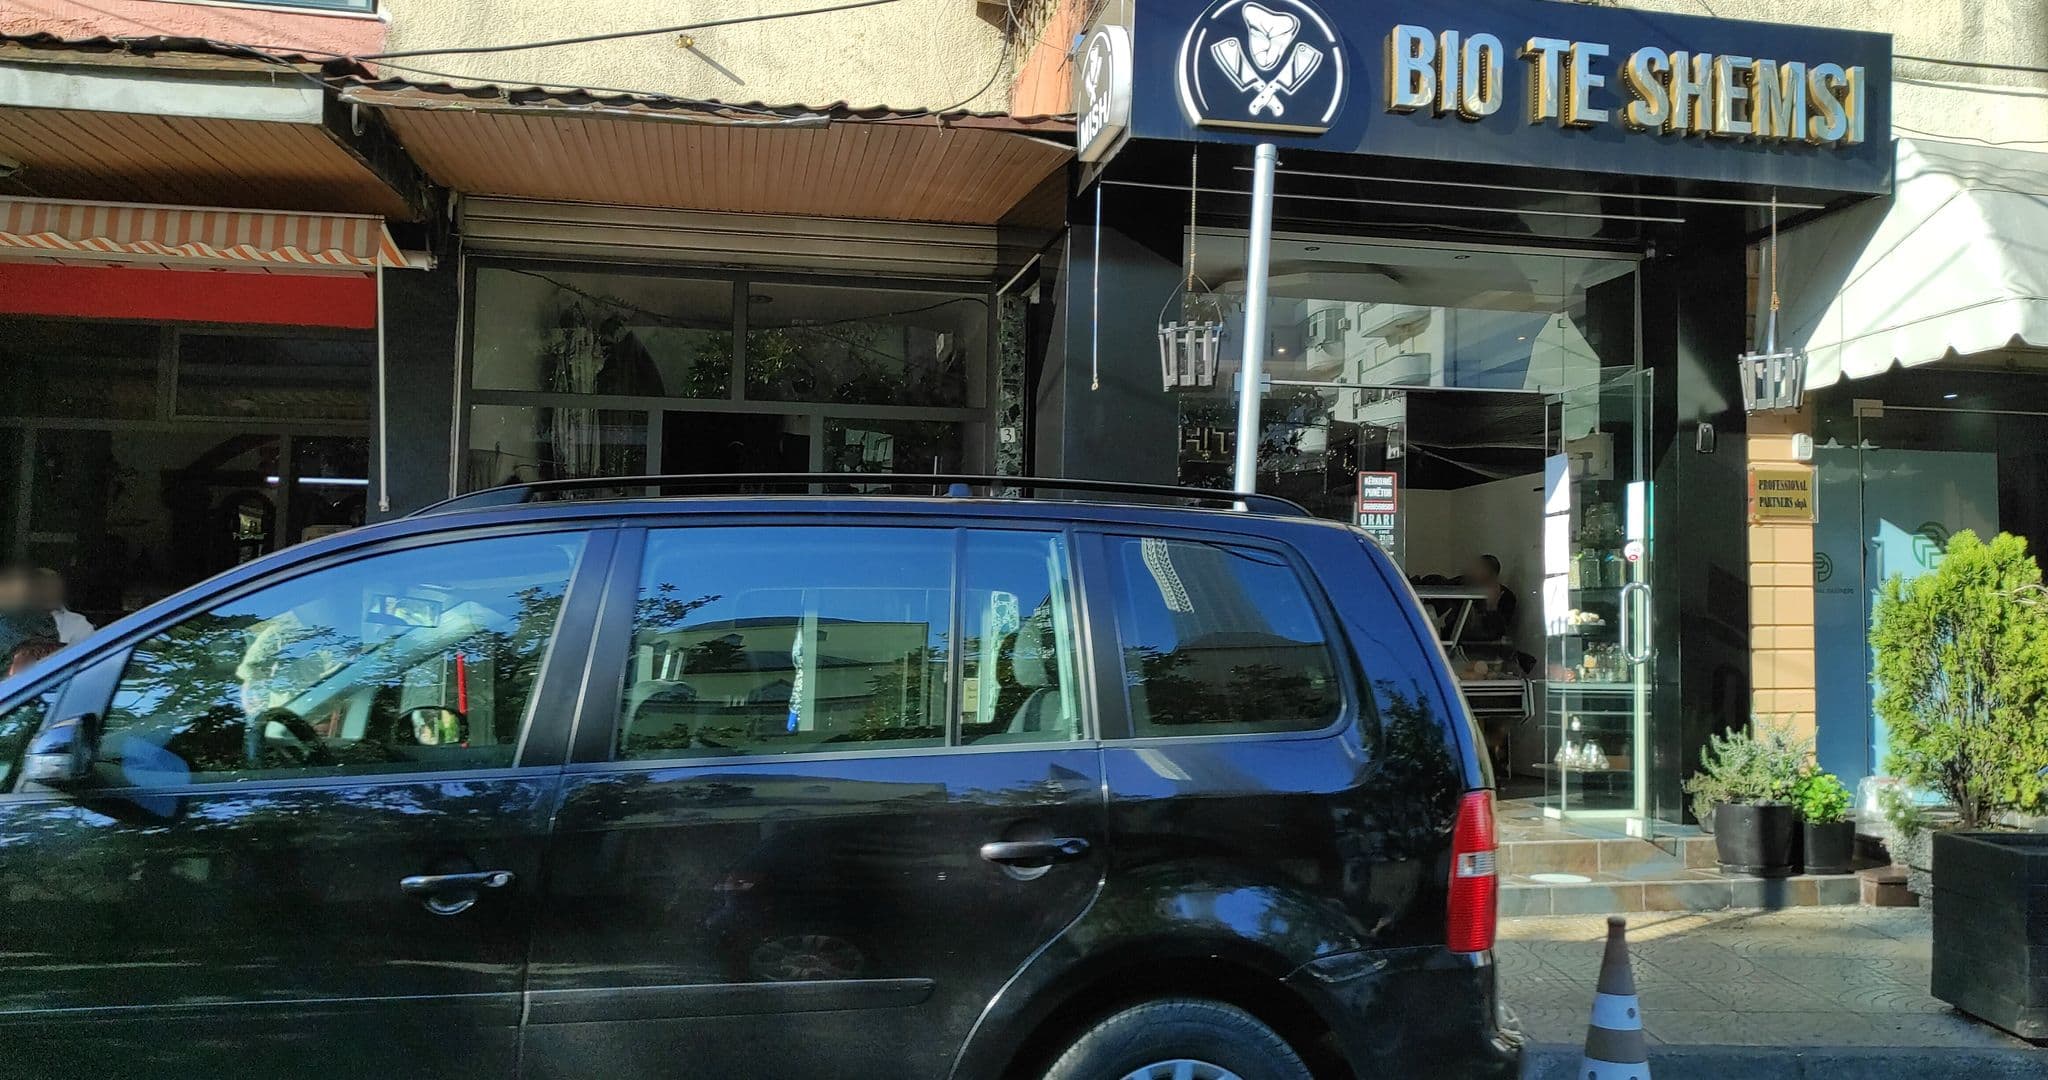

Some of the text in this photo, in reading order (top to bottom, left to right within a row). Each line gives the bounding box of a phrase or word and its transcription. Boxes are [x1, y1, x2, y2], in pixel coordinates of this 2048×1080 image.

[1390, 24, 1864, 143] BIO TE SHEMSI
[1079, 90, 1109, 152] MISH
[1004, 428, 1012, 441] 3
[1758, 479, 1808, 491] PROFESSIONAL
[1759, 496, 1793, 508] PARTNERS
[1360, 513, 1394, 526] ORARI
